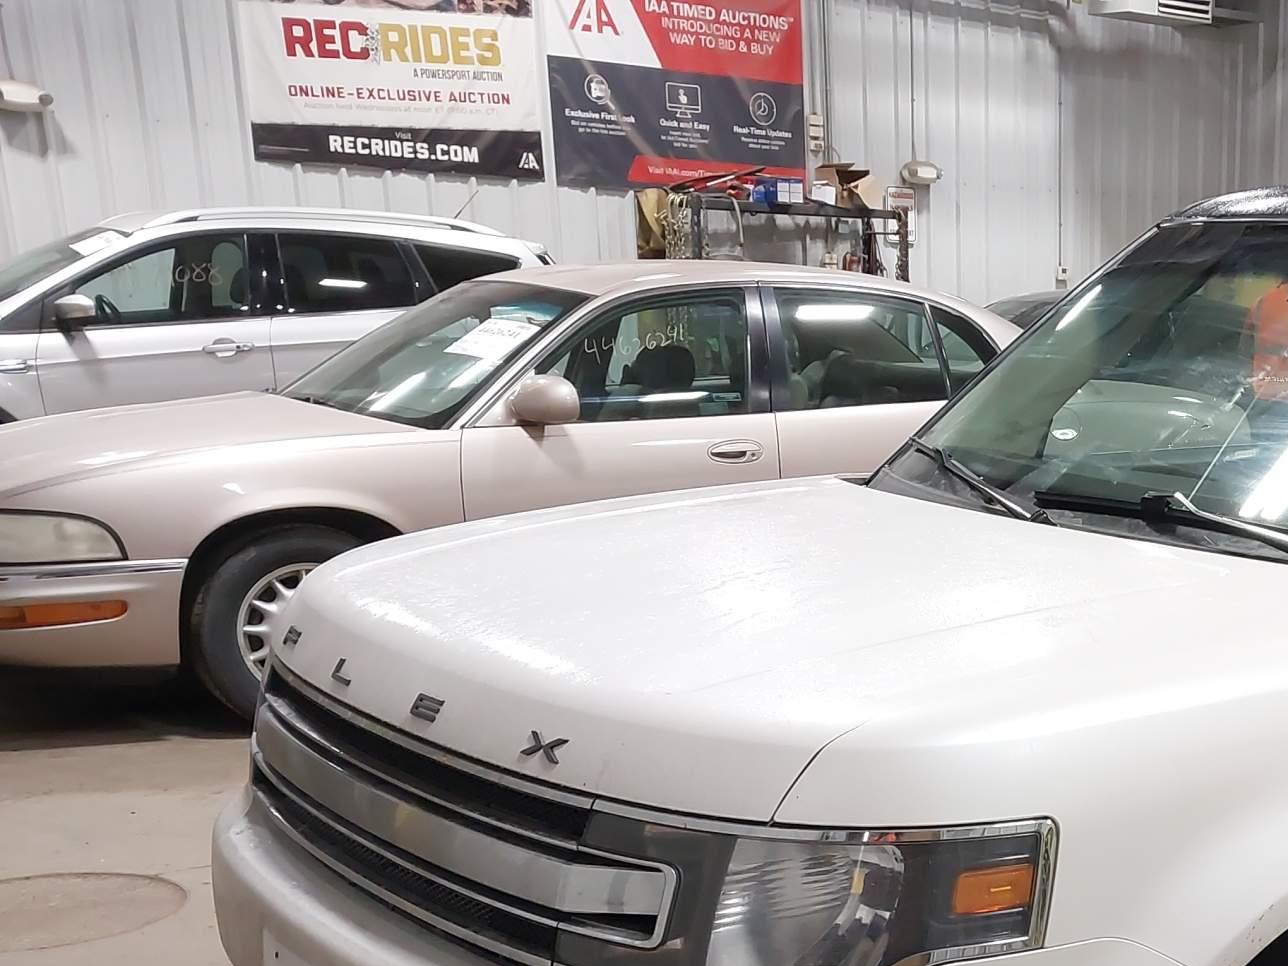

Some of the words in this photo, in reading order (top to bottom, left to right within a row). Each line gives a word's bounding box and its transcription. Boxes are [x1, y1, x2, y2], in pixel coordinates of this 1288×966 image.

[644, 0, 669, 15] IAA
[670, 2, 716, 21] TIMED
[661, 17, 741, 39] INTRODUCING
[743, 28, 752, 39] A
[755, 29, 781, 43] NEW
[669, 32, 696, 46] WAY
[699, 35, 716, 49] TO
[718, 38, 737, 51] BID
[739, 42, 748, 53] &
[750, 43, 774, 56] BUY
[413, 68, 419, 78] A
[420, 68, 471, 81] POWERSPORT
[472, 71, 503, 82] AUCTION
[288, 85, 442, 103] ONLINE-EXCLUSIVE
[449, 91, 511, 105] AUCTION
[565, 108, 600, 120] Exclusive
[601, 112, 617, 121] First
[659, 118, 679, 128] Quick
[679, 121, 693, 129] and
[694, 121, 710, 132] Easy
[733, 125, 766, 136] Real-Time
[767, 128, 793, 138] Updates
[395, 131, 412, 139] Visit
[329, 134, 479, 163] RECRIDES.COM
[647, 165, 664, 175] Visit
